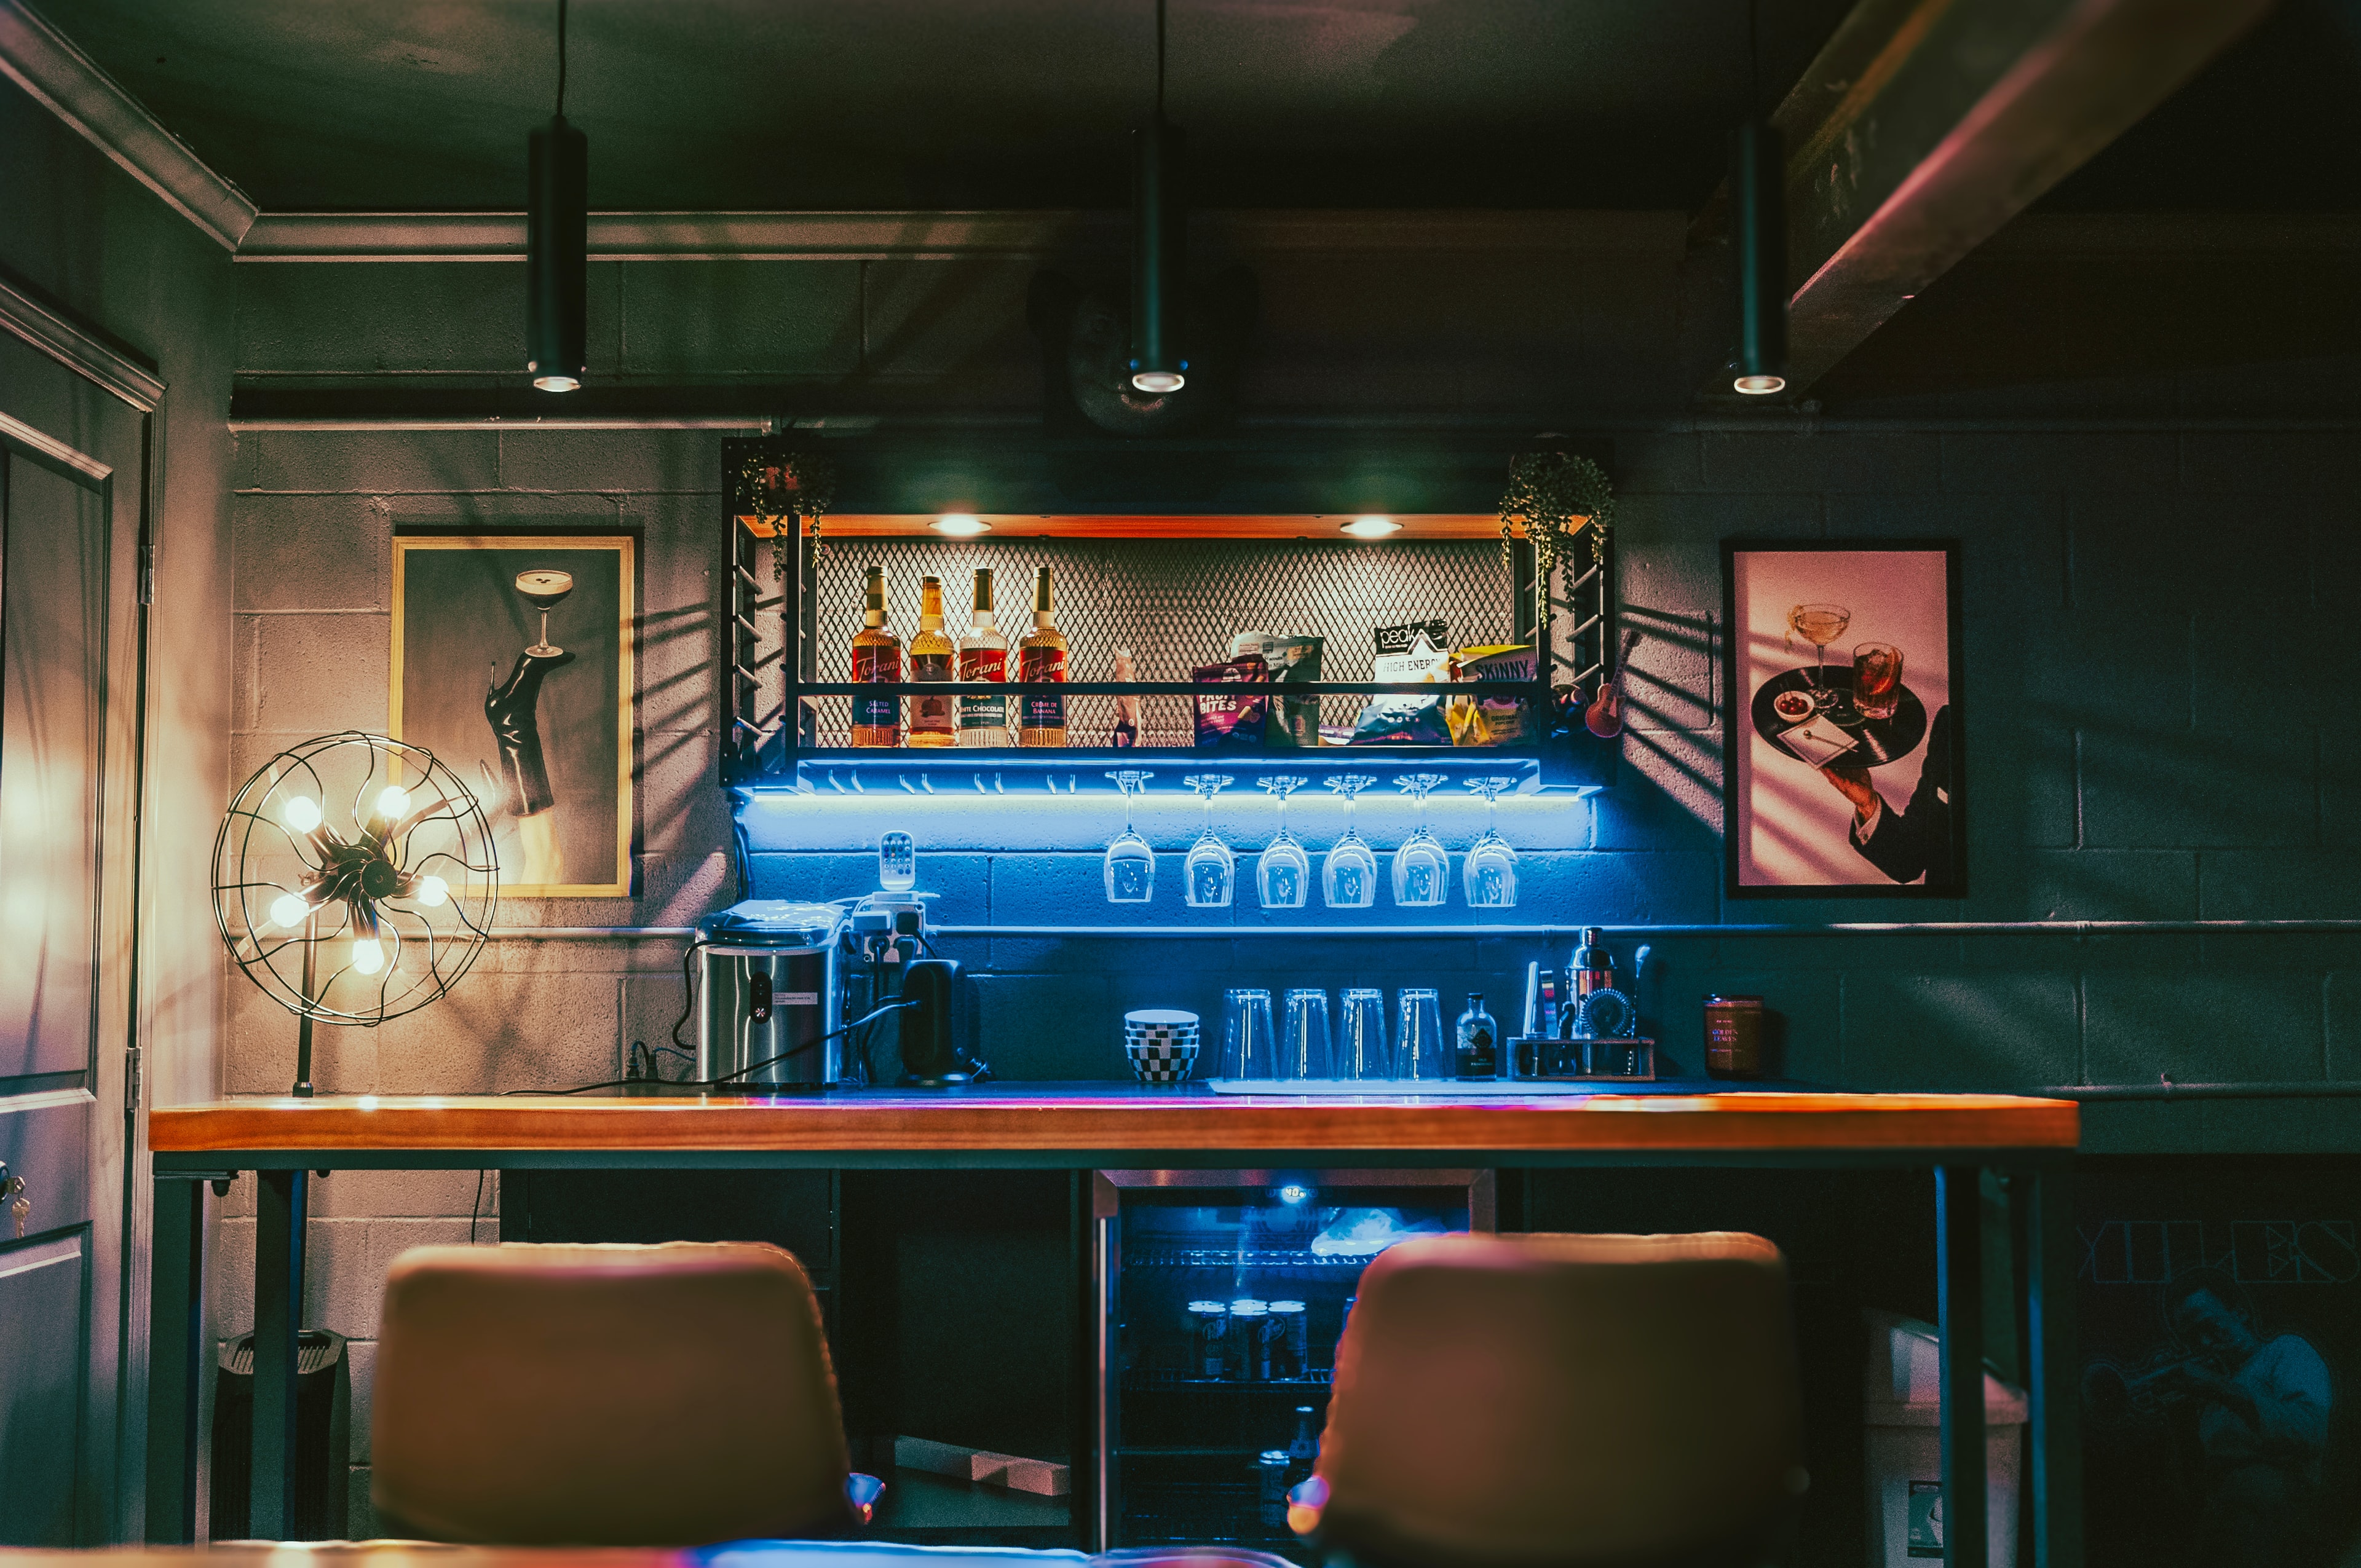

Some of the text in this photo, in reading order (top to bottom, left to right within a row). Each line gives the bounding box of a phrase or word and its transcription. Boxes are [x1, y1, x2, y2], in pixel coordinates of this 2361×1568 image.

[1380, 624, 1415, 648] peak
[856, 656, 900, 684] Torani
[960, 658, 1003, 682] Torani
[1022, 656, 1065, 682] Torani
[1200, 700, 1236, 715] BITES
